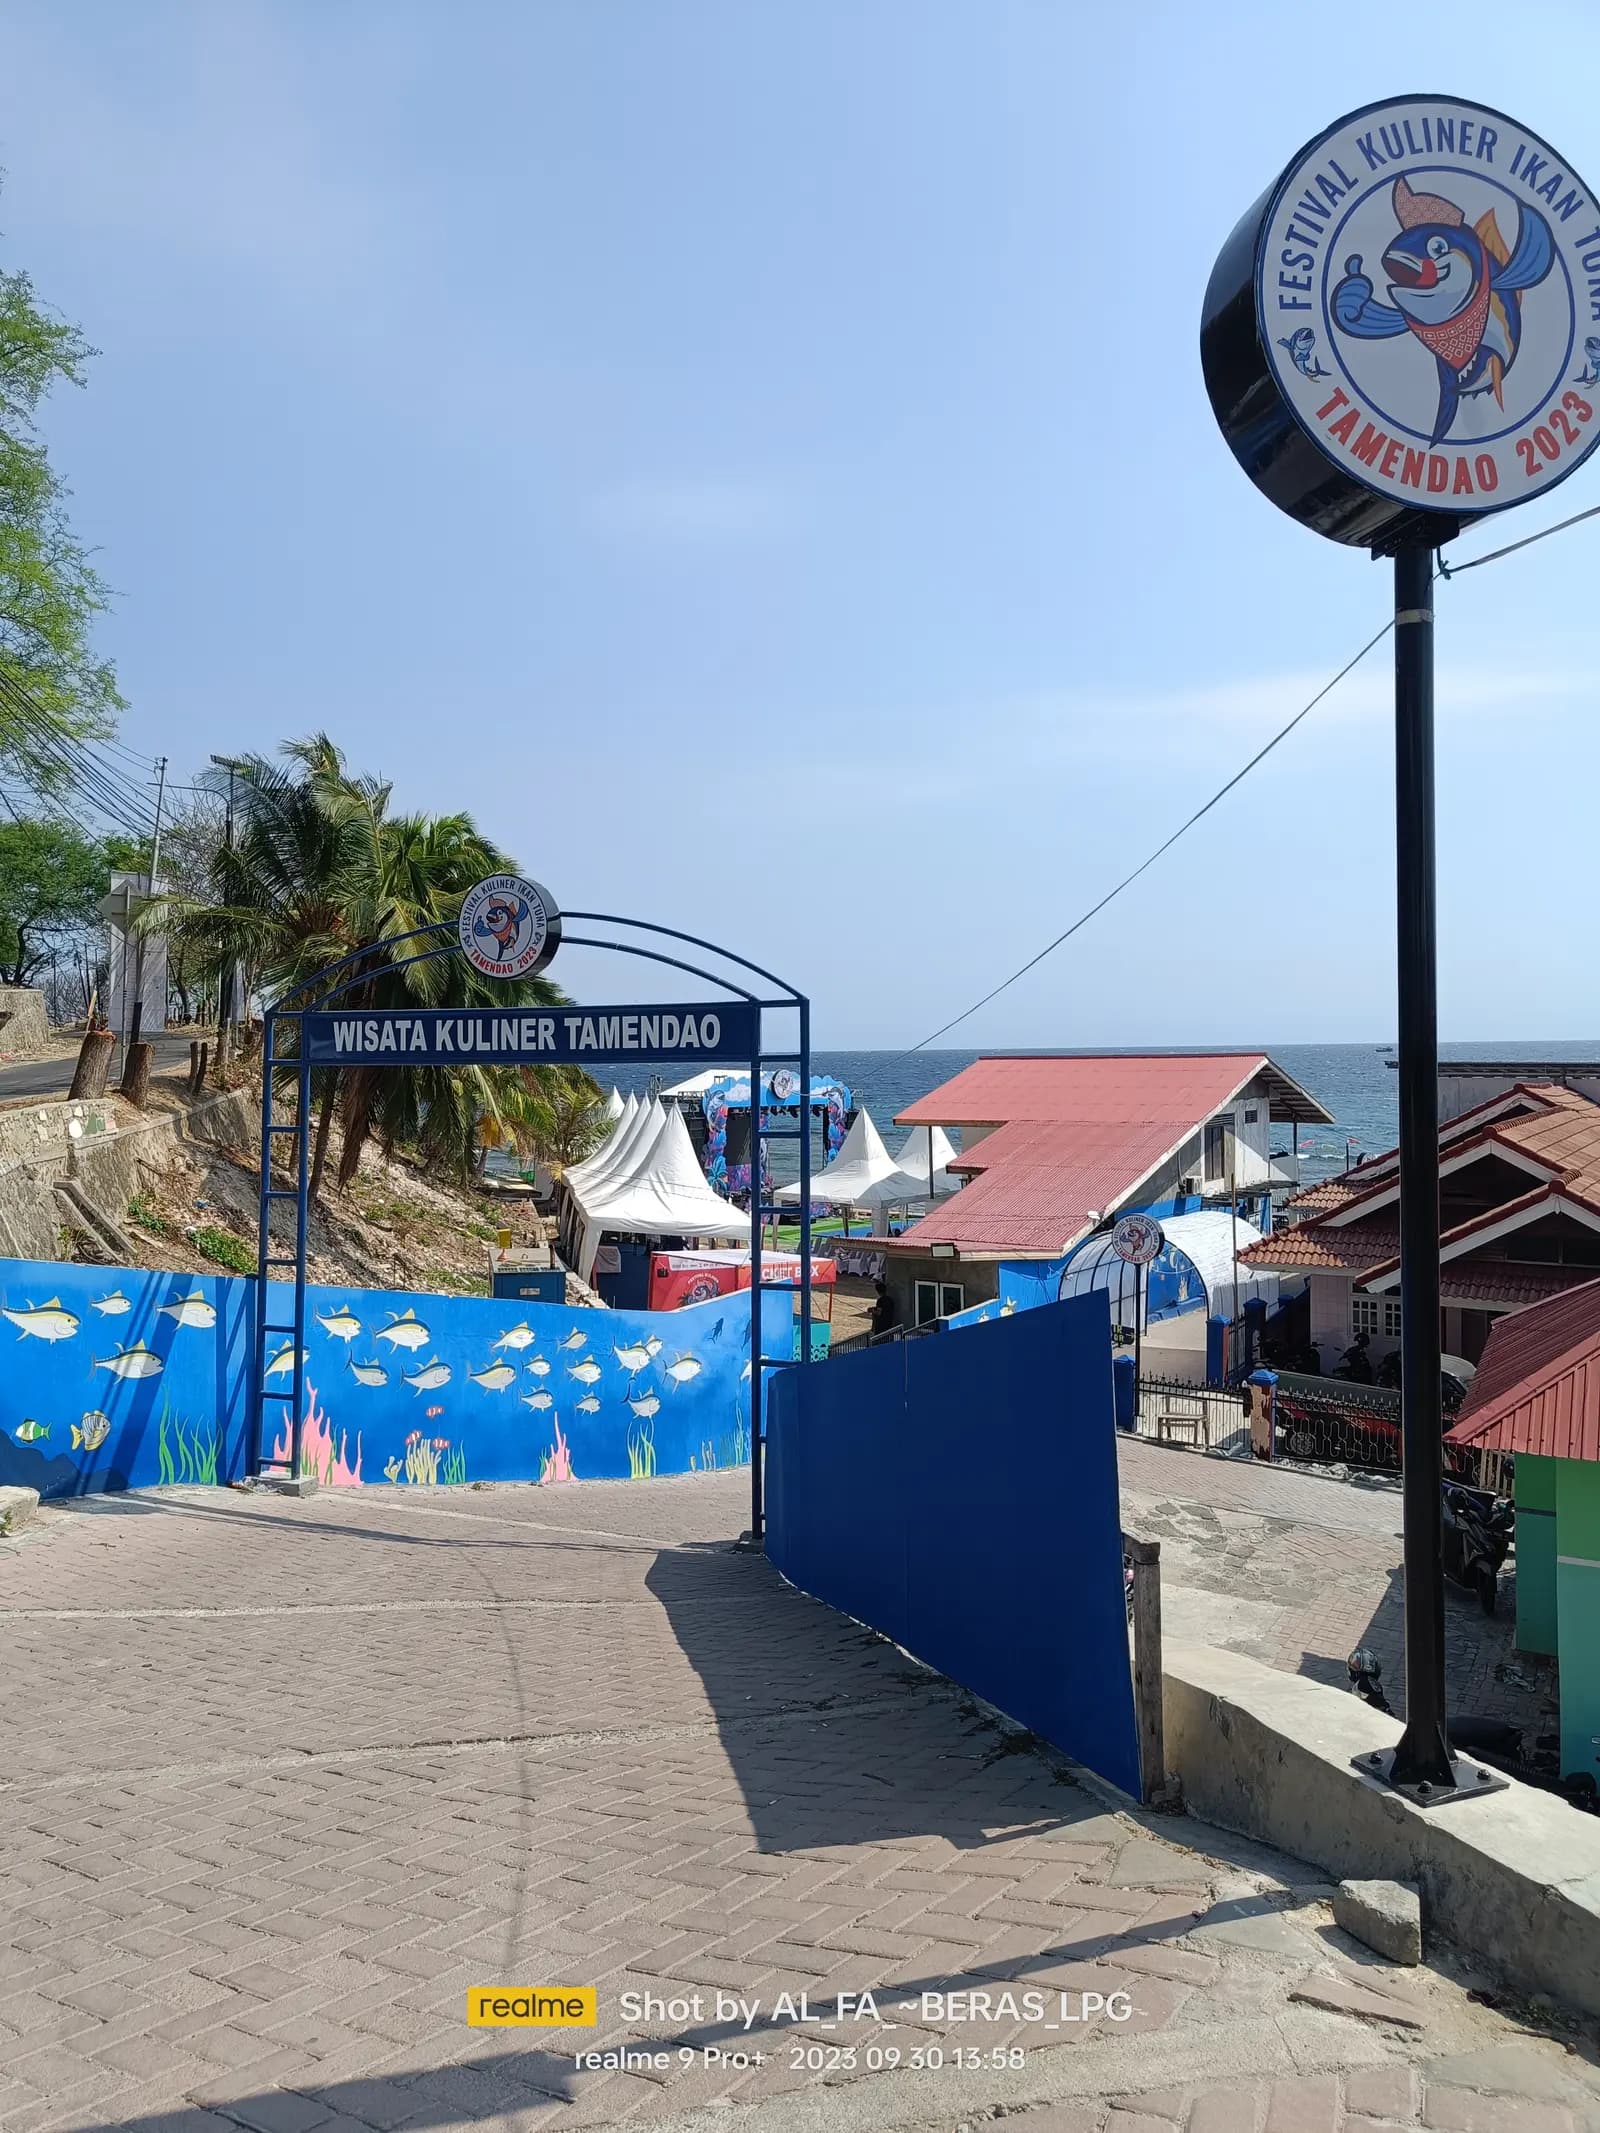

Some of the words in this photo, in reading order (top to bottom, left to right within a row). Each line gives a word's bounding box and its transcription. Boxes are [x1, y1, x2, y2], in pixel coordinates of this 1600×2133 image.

[1280, 158, 1360, 311] FESTIVAL
[1356, 117, 1498, 171] KULINER
[1509, 144, 1584, 225] IKAN
[1315, 387, 1499, 494] TAMENDAO
[1516, 390, 1593, 477] 2023
[462, 892, 482, 931] FESTIVAL
[480, 879, 516, 895] KULINER
[517, 883, 537, 903] IKAN
[532, 903, 545, 928] TUNA
[470, 949, 513, 974] TAMENDAO
[517, 946, 537, 968] 2023
[333, 1019, 428, 1052] WISATA
[436, 1017, 556, 1051] KULINER
[564, 1013, 721, 1050] TAMENDAO
